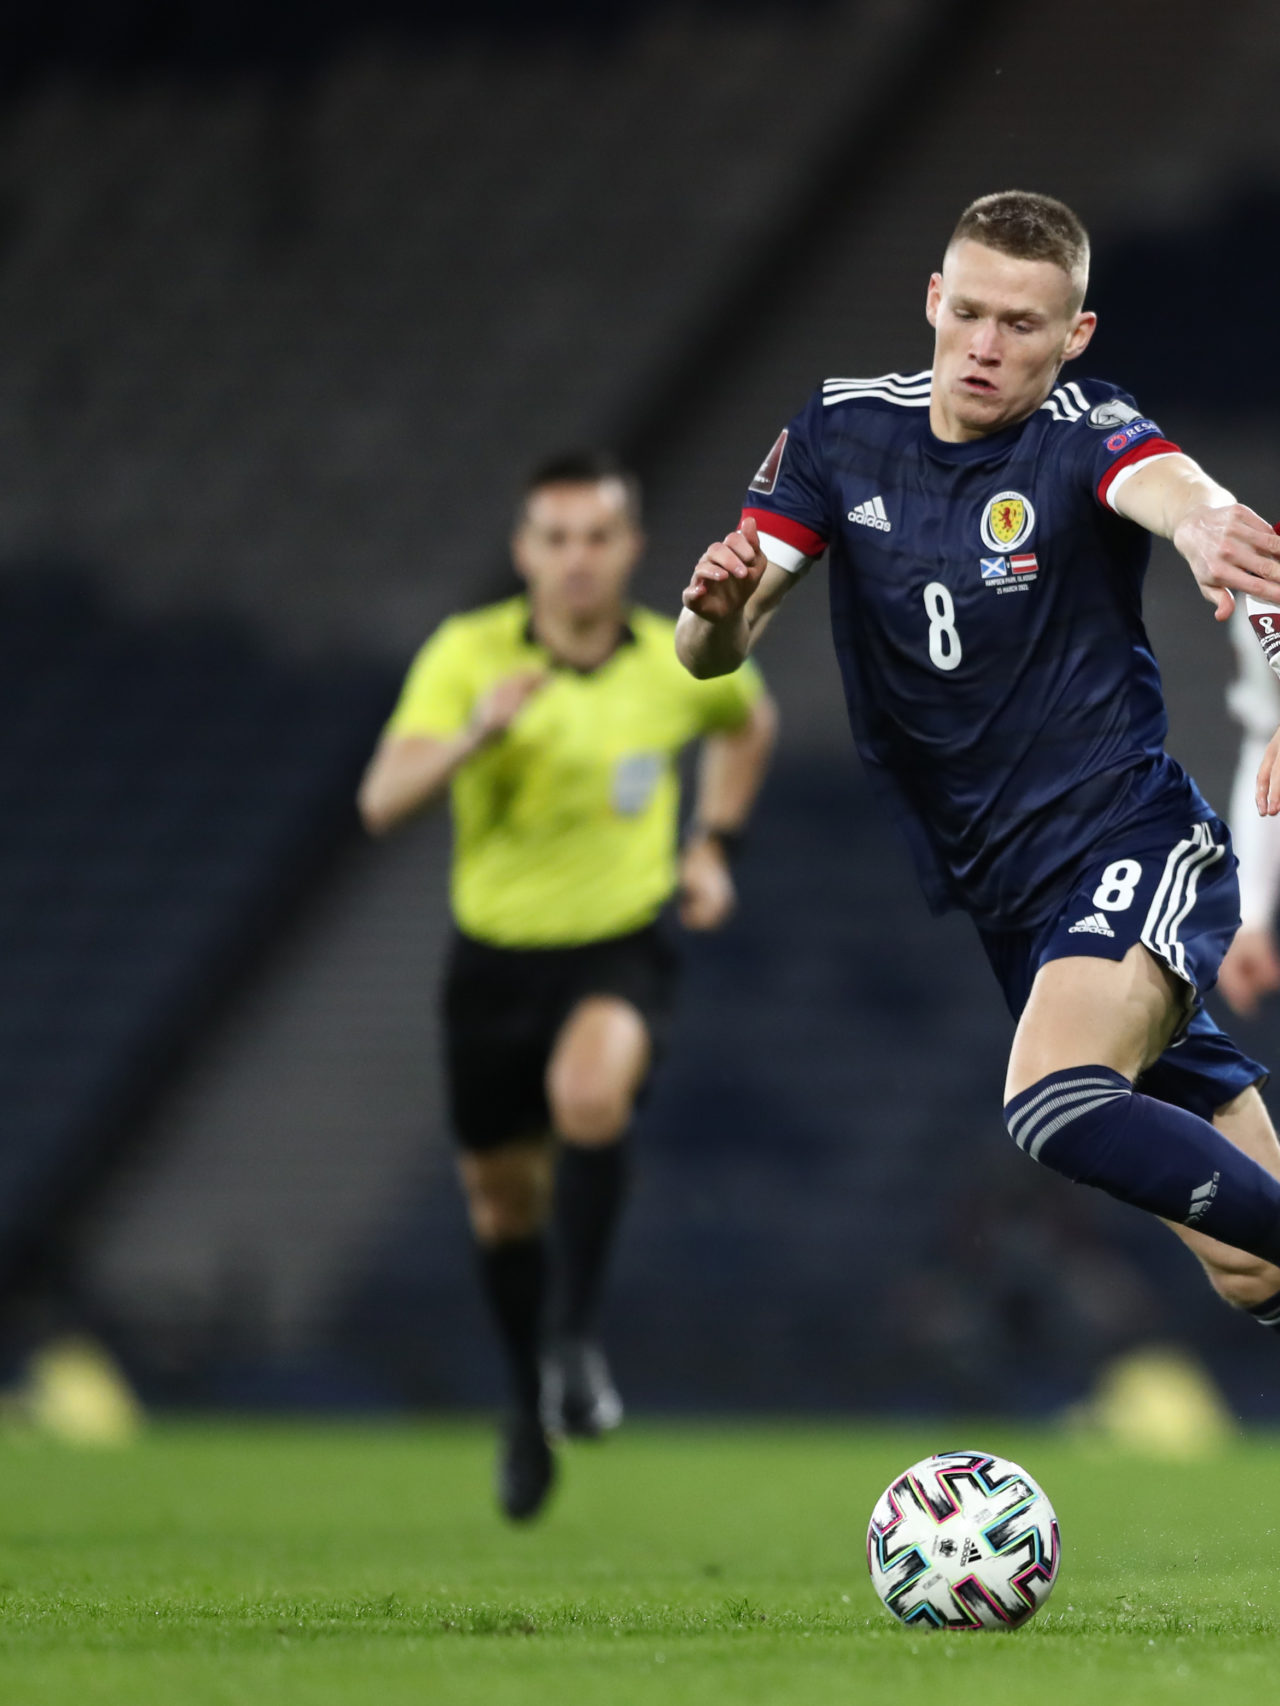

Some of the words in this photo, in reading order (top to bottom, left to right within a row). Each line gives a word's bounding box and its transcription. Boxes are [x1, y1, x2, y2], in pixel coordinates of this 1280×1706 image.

[848, 510, 891, 532] adidas
[923, 582, 962, 671] 8
[1092, 859, 1142, 912] 8
[1068, 926, 1115, 938] adidas
